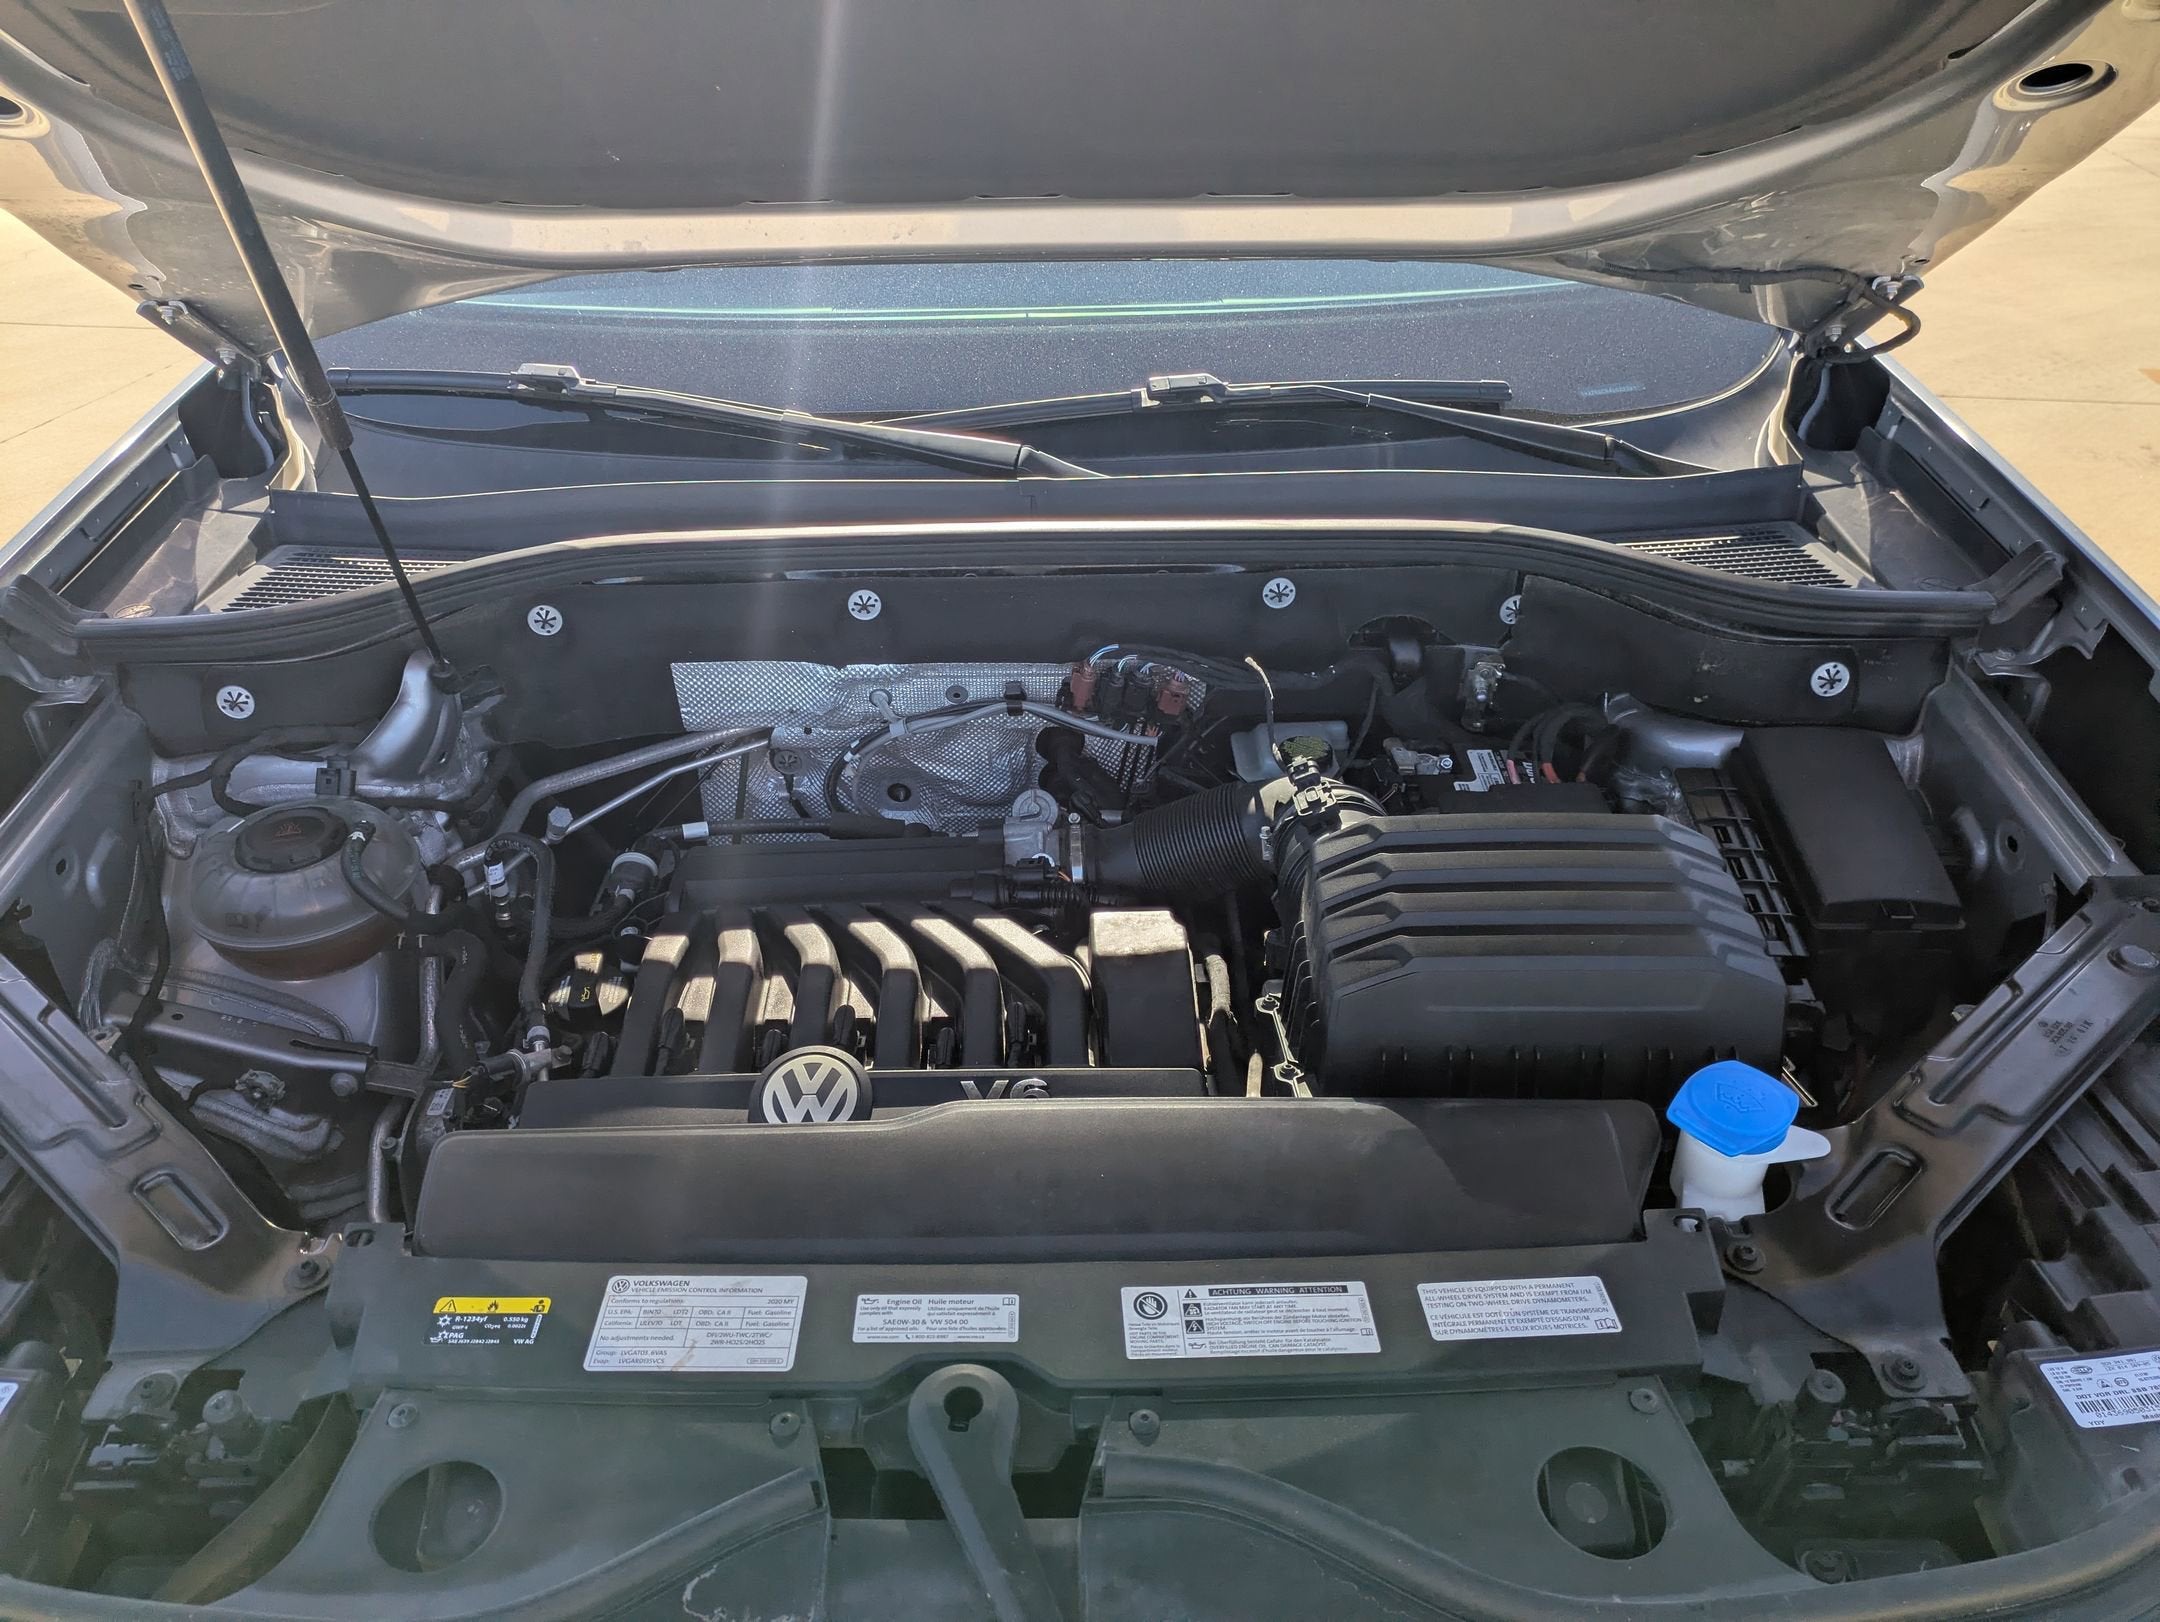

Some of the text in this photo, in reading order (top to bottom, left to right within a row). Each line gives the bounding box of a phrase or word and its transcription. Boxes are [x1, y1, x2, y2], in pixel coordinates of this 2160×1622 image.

[1534, 1282, 1575, 1290] PERMANENT
[1212, 1288, 1251, 1296] ACHTUNG
[1300, 1286, 1342, 1294] ATTENTION
[886, 1298, 910, 1306] Engine
[1559, 1306, 1609, 1314] TRANSMISSION
[455, 1315, 488, 1323] R-1234yf
